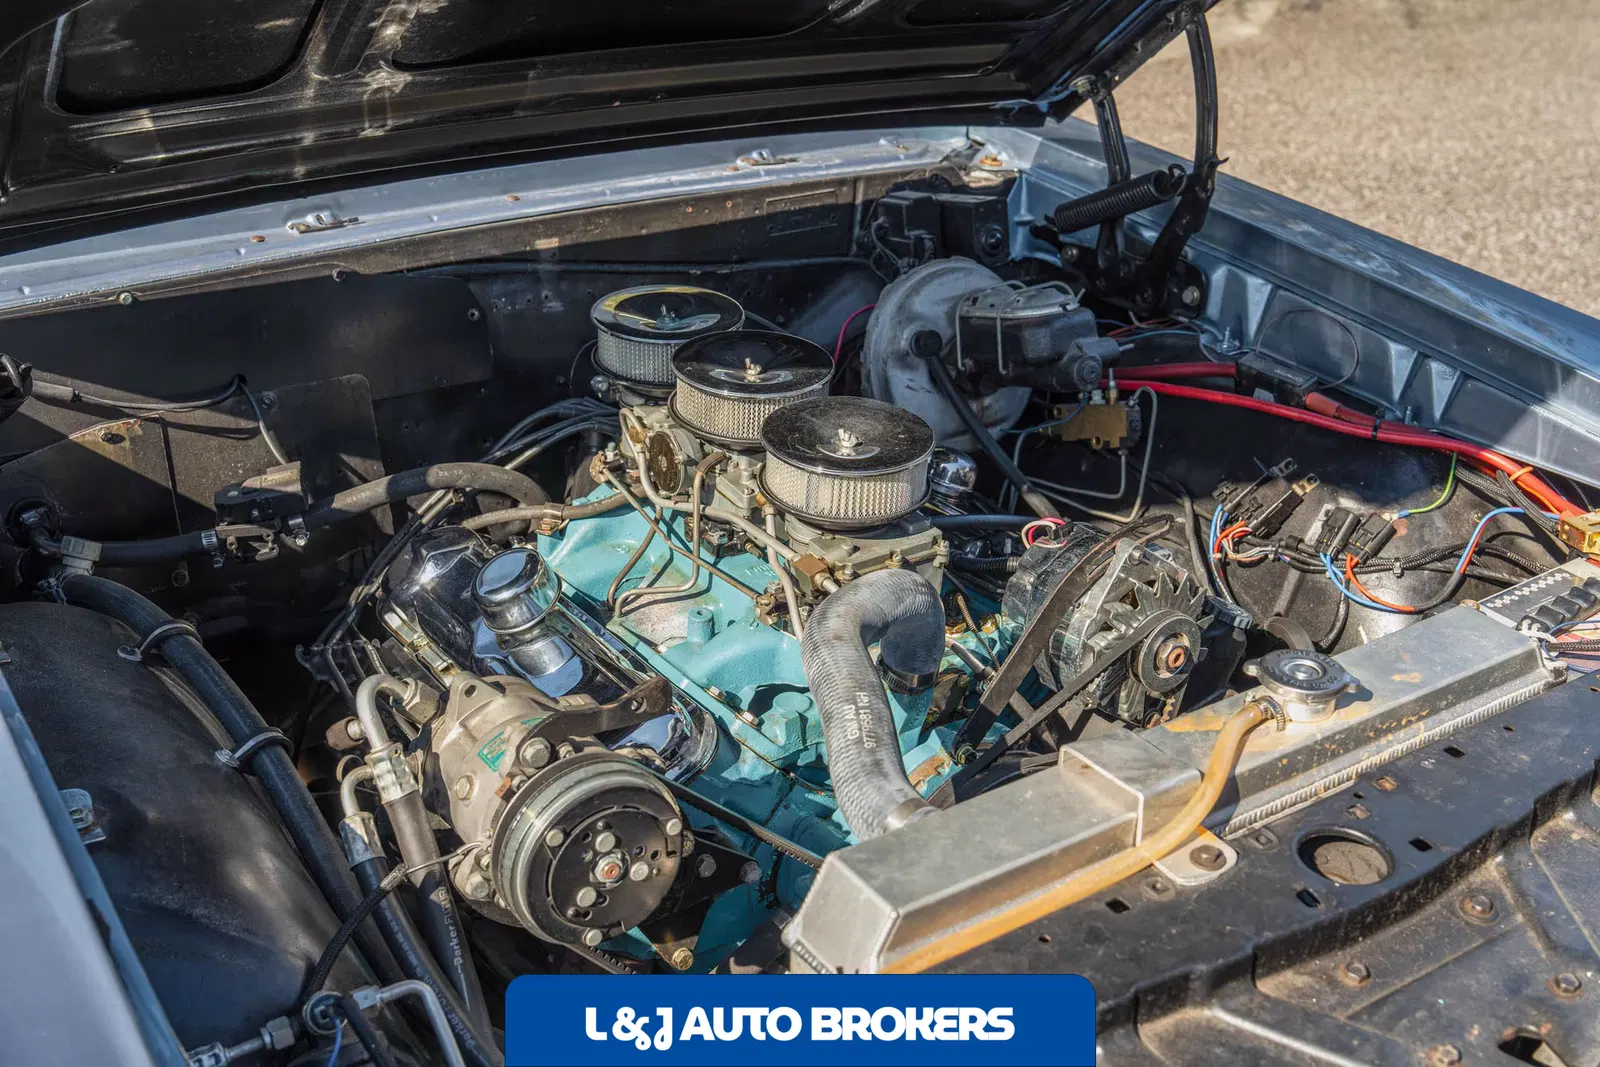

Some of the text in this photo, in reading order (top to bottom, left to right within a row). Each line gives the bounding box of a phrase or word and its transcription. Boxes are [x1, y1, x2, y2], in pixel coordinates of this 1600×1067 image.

[843, 704, 860, 740] GM AU
[858, 709, 877, 749] 9779581
[449, 925, 463, 967] Parker
